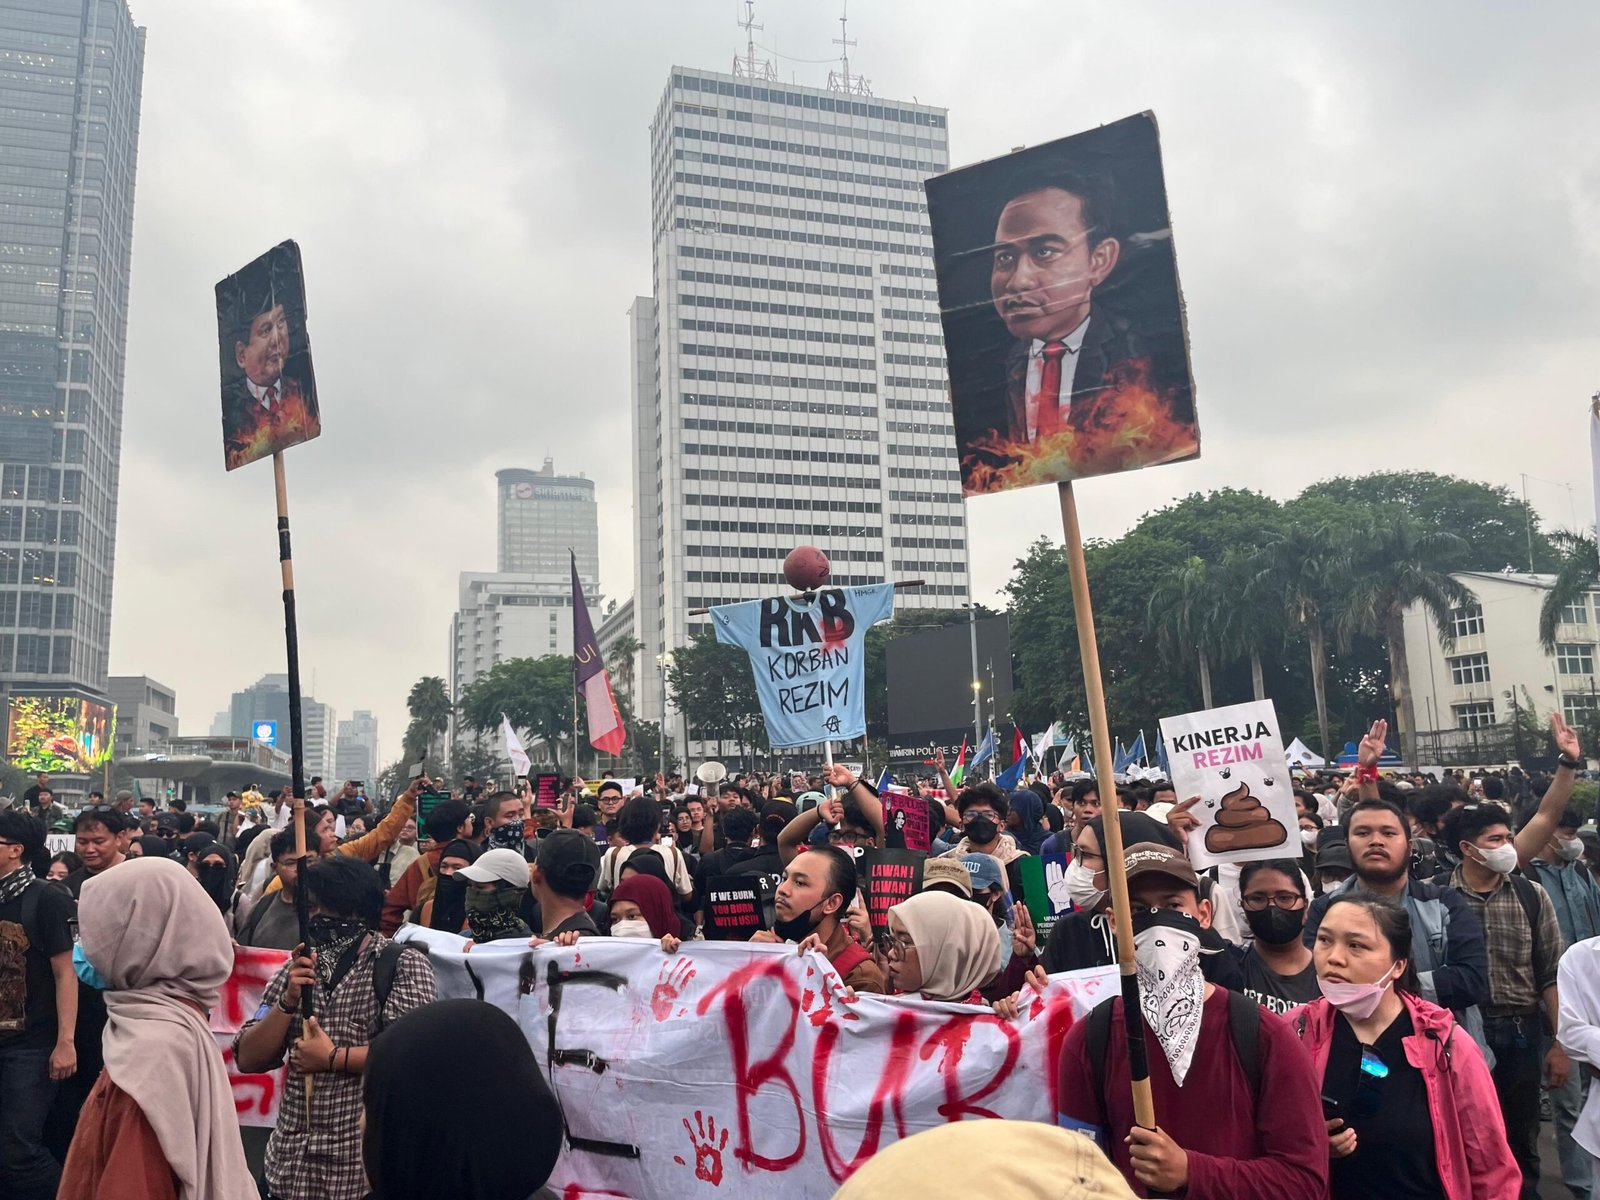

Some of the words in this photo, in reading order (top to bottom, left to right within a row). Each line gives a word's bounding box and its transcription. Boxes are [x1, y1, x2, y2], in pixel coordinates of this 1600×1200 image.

[760, 588, 855, 648] RKB
[767, 646, 849, 682] KORBAN
[778, 677, 849, 716] REZIM
[1172, 721, 1272, 753] KINERJA
[1192, 742, 1263, 769] REZIM
[871, 865, 908, 878] LAWAN
[710, 892, 717, 902] IF
[718, 891, 732, 901] WE
[870, 881, 906, 894] LAWAN
[712, 904, 729, 914] YOU
[730, 903, 754, 914] BURN
[714, 916, 738, 927] WITH
